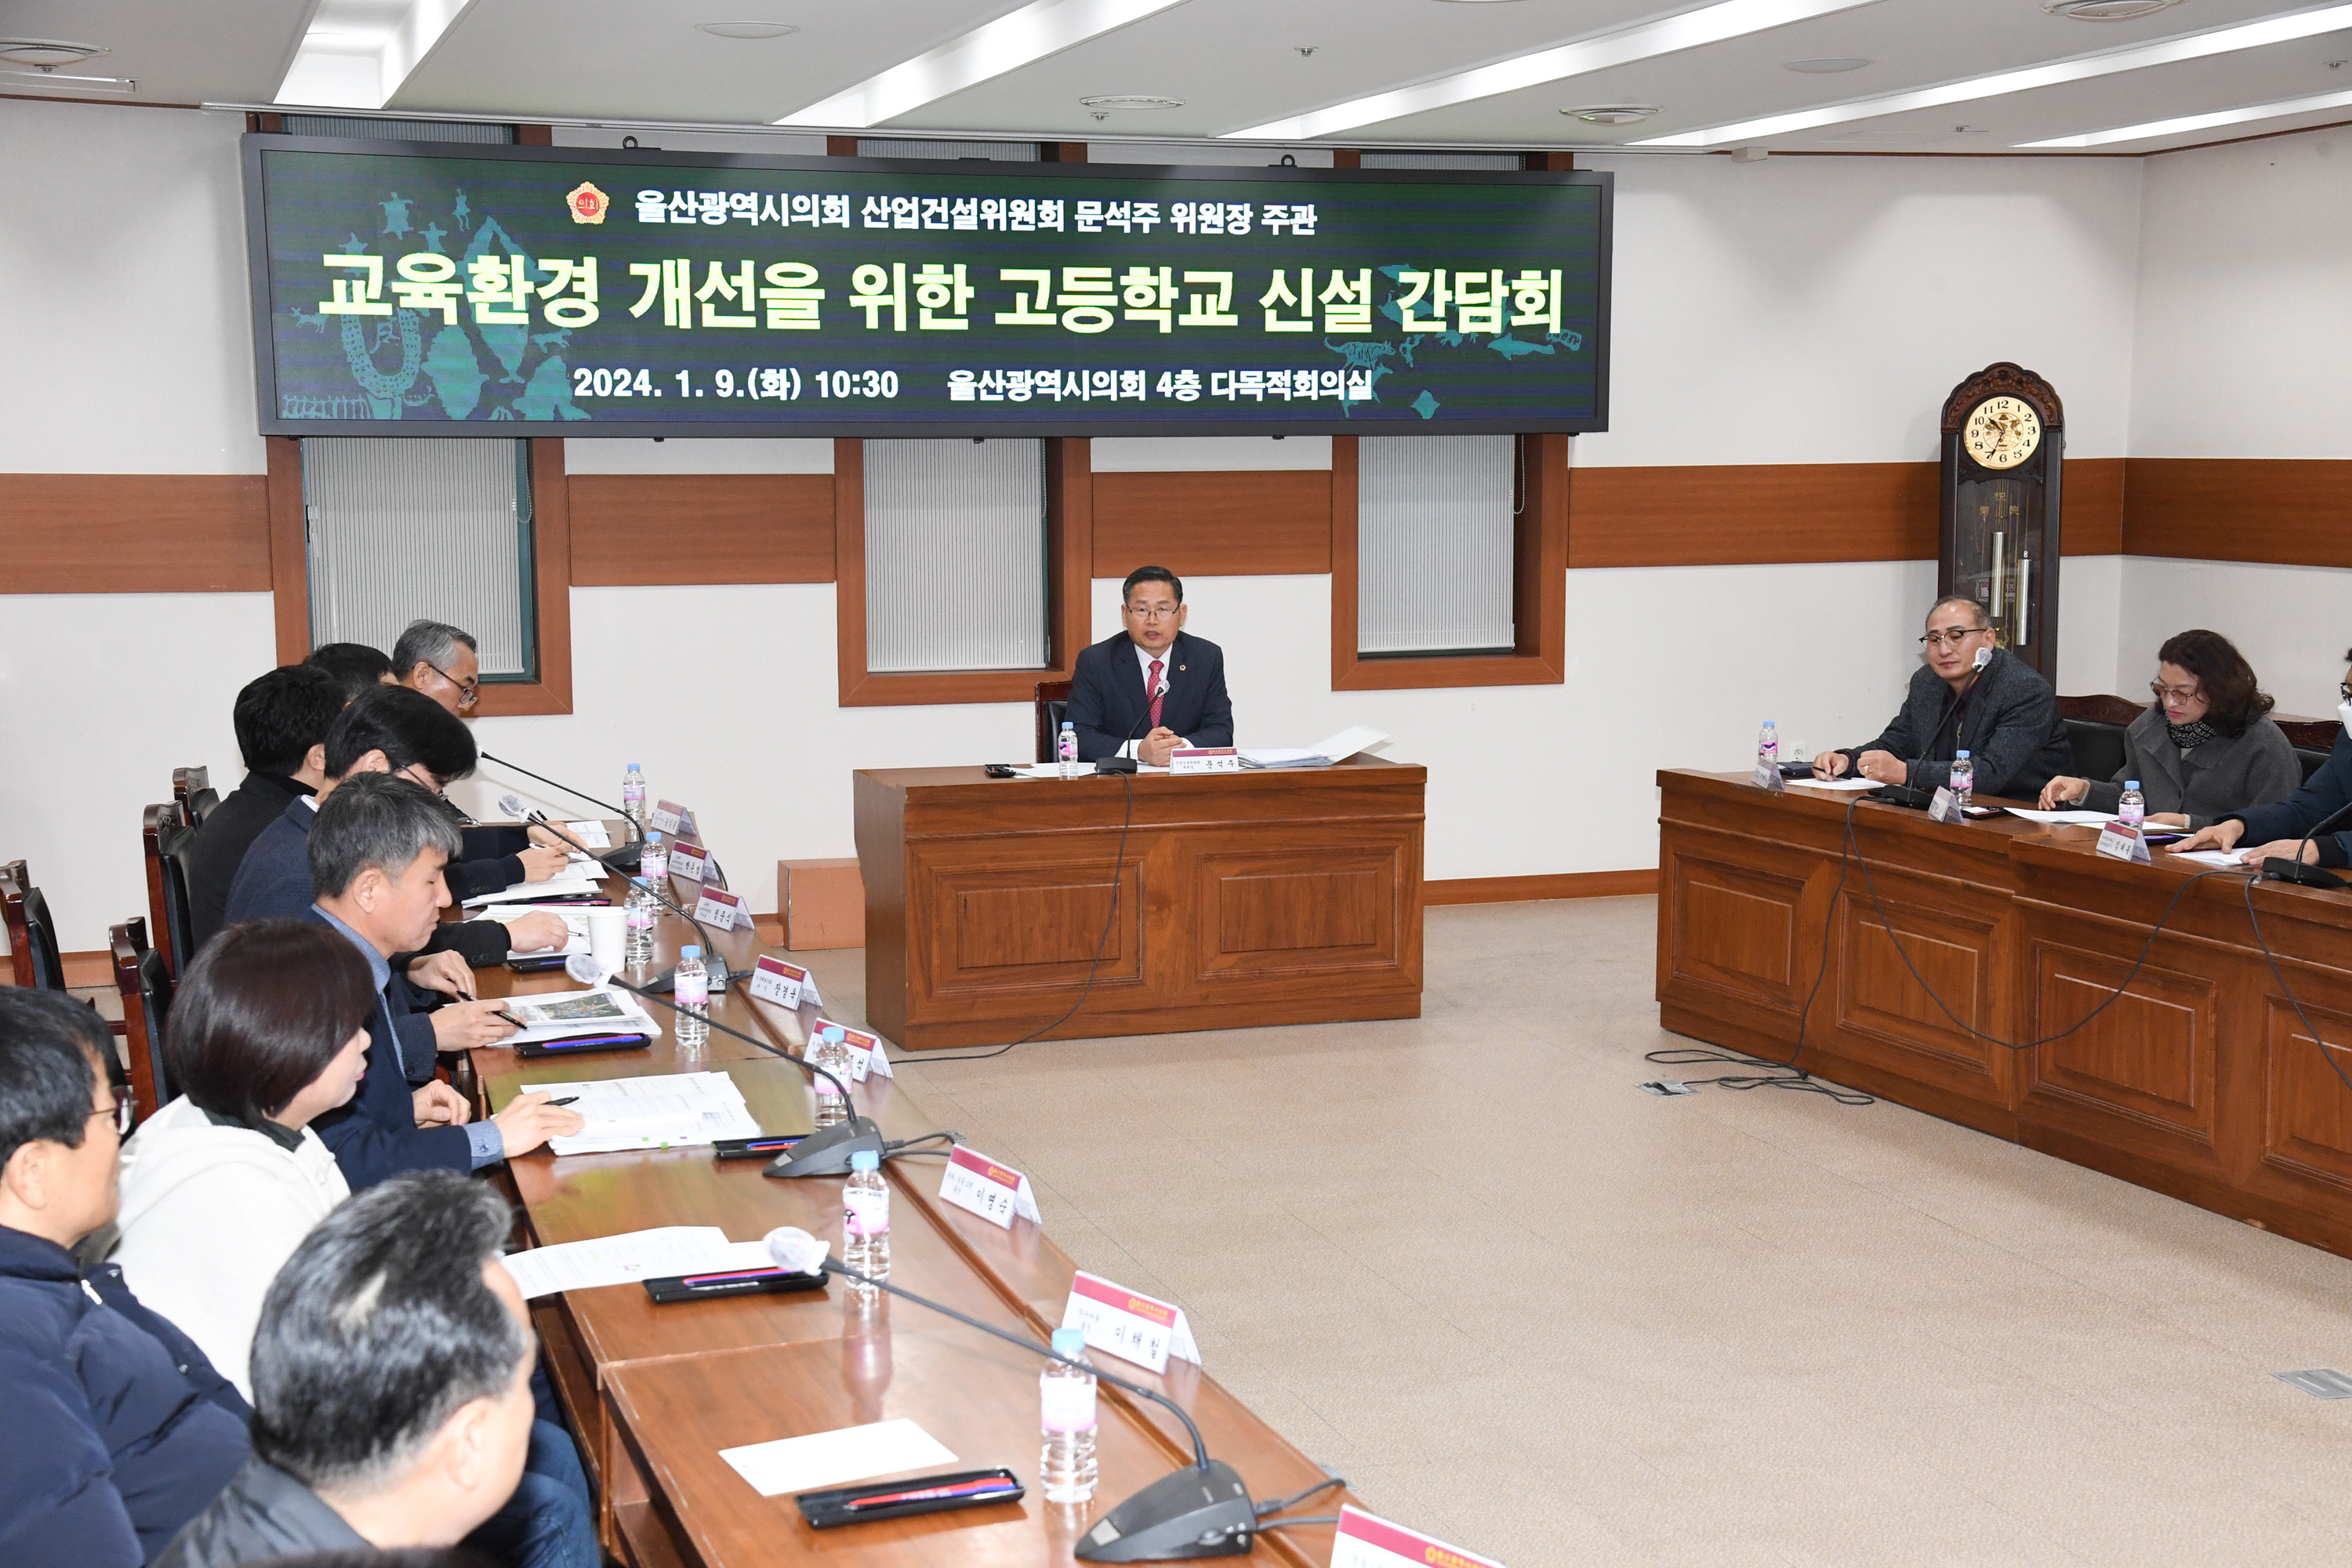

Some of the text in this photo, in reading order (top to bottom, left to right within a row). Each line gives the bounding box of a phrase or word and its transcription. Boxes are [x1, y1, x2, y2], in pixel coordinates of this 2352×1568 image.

[635, 190, 1318, 235] 울산광역시의회 산업건설위원회 문석주 위원장 주관
[318, 252, 1563, 334] 교육환경 개선을 위한 고등학교 신설 간담회
[573, 367, 1372, 402] 2024. 1. 9.(화) 10:30 울산광역시의회 4층 다목적회의실
[1997, 400, 2009, 409] 12
[1984, 405, 1993, 414] 11
[1975, 416, 1984, 425] 10
[2024, 413, 2032, 422] 2
[1971, 429, 1979, 437] 9
[2027, 426, 2036, 435] 3
[1974, 441, 1984, 450] 8
[1999, 454, 2007, 463] 6
[2013, 449, 2022, 459] 5
[1206, 760, 1235, 769] 문석주
